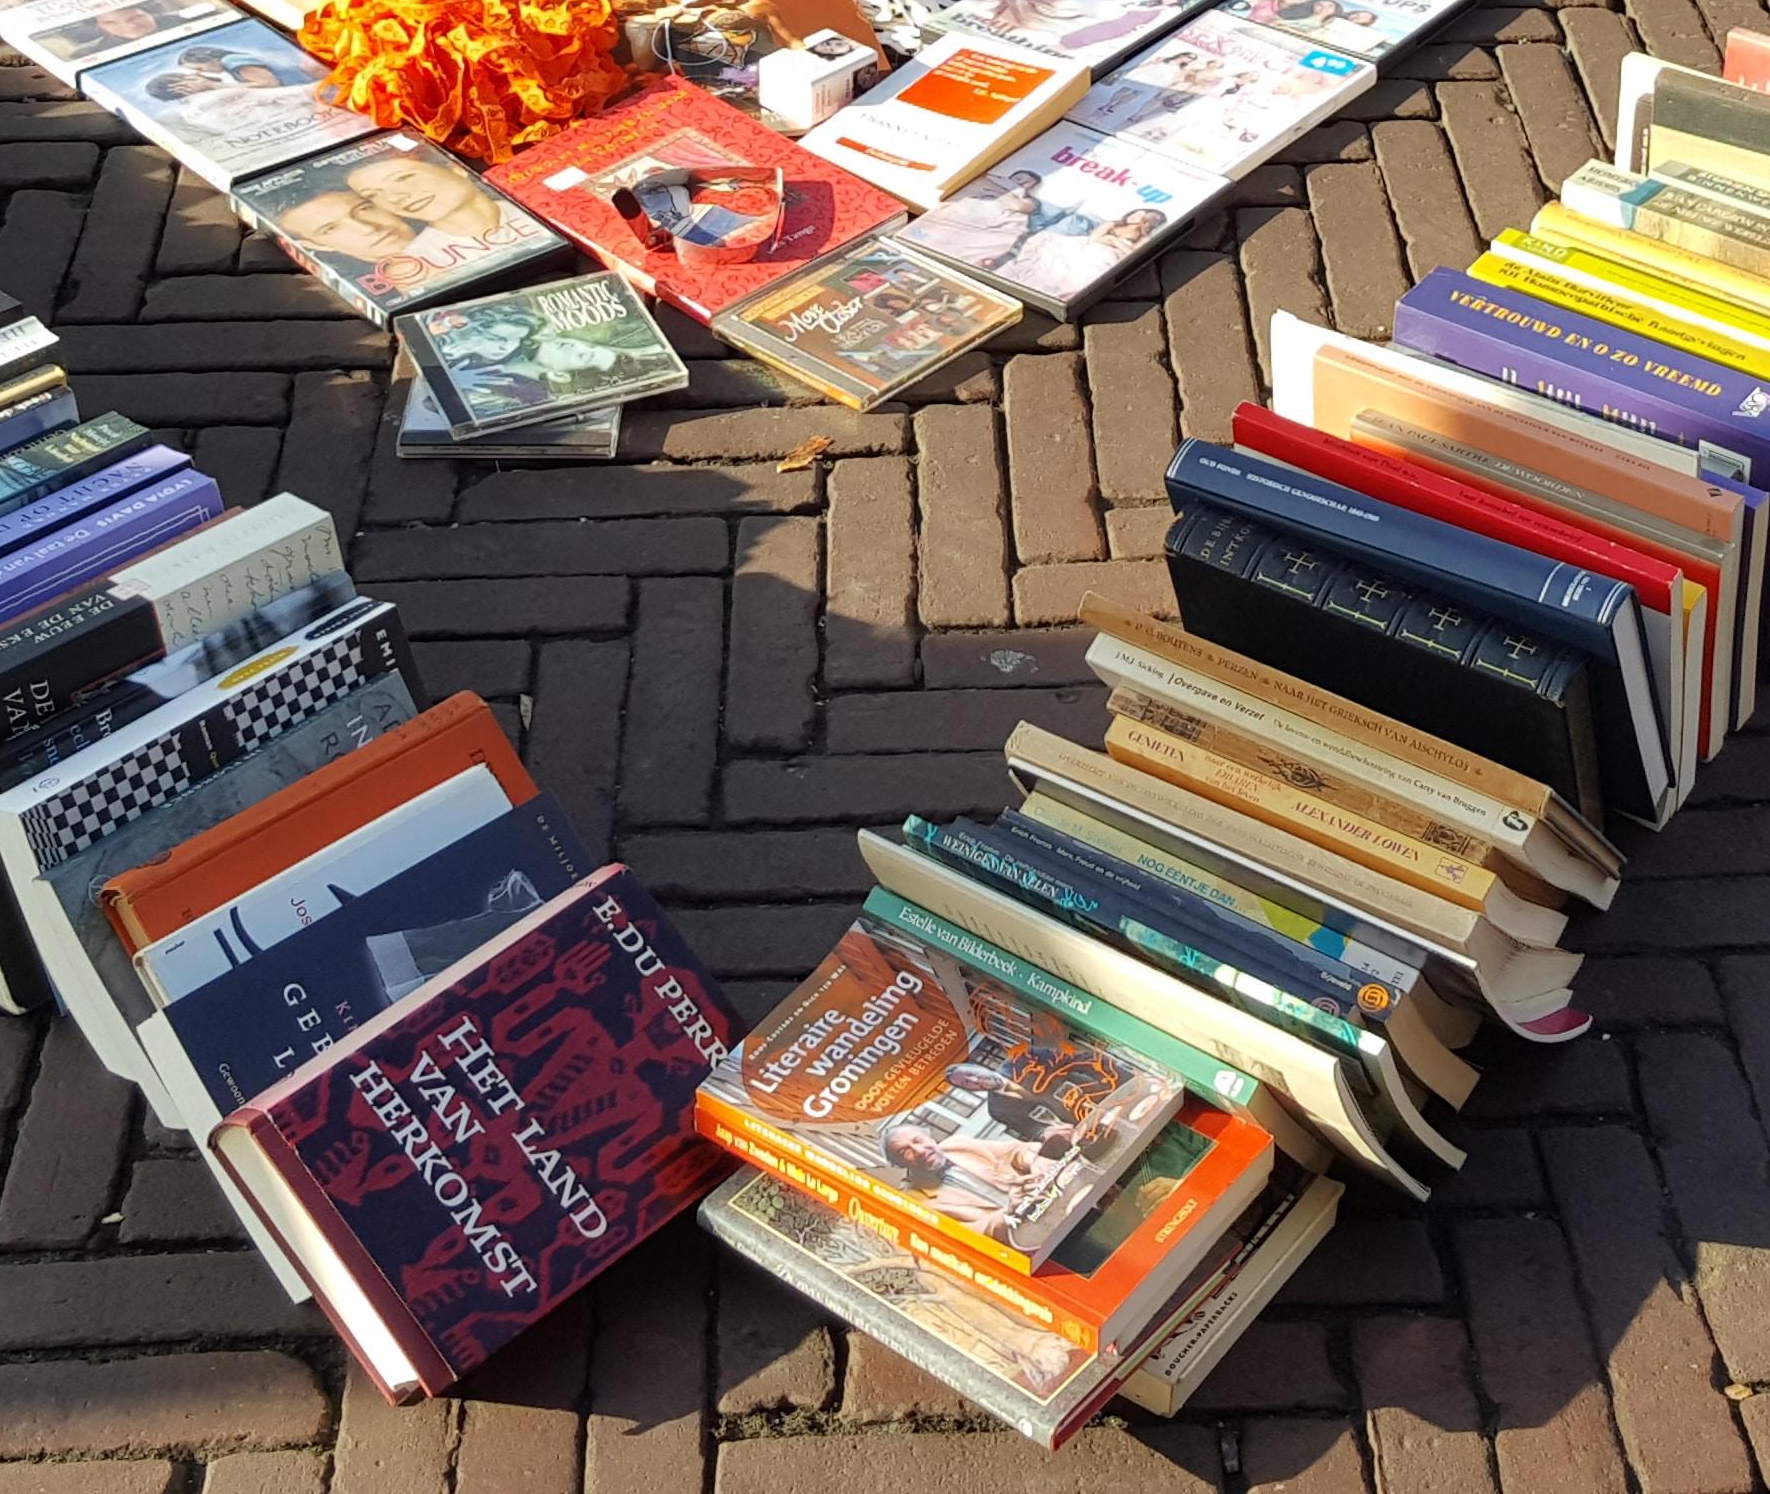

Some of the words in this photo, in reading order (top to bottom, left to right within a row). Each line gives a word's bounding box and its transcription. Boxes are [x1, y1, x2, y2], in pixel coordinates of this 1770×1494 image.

[1047, 141, 1178, 211] break-up
[351, 203, 541, 302] BOUNCE
[536, 278, 613, 314] ROMANTIC
[547, 296, 628, 332] MOODS
[1448, 288, 1564, 341] VERTROUWD
[1563, 331, 1594, 352] EN
[1591, 341, 1611, 358] O
[1608, 348, 1639, 368] ZO
[1642, 359, 1723, 399] VREEMD
[1440, 439, 1489, 464] SARTRE
[55, 458, 144, 507] NACHT
[141, 474, 194, 506] LYDIA
[15, 501, 50, 525] OP
[93, 498, 145, 529] DAVIS
[32, 537, 67, 561] taal
[62, 524, 91, 545] De
[3, 552, 35, 573] van
[35, 611, 64, 630] DE
[66, 591, 107, 615] VAN
[86, 598, 114, 616] DE
[29, 612, 86, 645] EEUW
[1155, 629, 1204, 658] BOUTENS
[1216, 656, 1258, 682] PERZEN
[26, 677, 58, 717] DE
[1172, 675, 1219, 704] Overgave
[1218, 696, 1233, 708] en
[1233, 701, 1265, 722] Verzet
[1272, 679, 1305, 701] NAAR
[1304, 693, 1329, 710] HET
[1327, 703, 1383, 734] GRIEKSCH
[1383, 726, 1408, 745] VAN
[1408, 737, 1471, 772] AISCHYLOS
[1126, 728, 1187, 764] GENIETEN
[1203, 753, 1225, 768] naar
[1224, 762, 1243, 775] een
[1241, 768, 1283, 792] werkelijk
[1204, 774, 1222, 787] van
[1220, 780, 1238, 793] het
[1236, 787, 1261, 803] leven
[1410, 777, 1437, 798] Carry
[1435, 789, 1452, 802] van
[1450, 795, 1488, 820] Bruggen
[535, 814, 550, 832] DE
[1010, 825, 1029, 839] Erich
[1290, 797, 1373, 842] ALEXANDER
[1371, 832, 1423, 863] LOWEN
[1094, 864, 1105, 874] en
[1104, 868, 1115, 878] de
[1136, 852, 1166, 874] NOG
[897, 904, 938, 935] Estelle
[934, 926, 960, 947] van
[955, 935, 1019, 977] Bilderbeek
[1023, 970, 1093, 1018] Kampkind
[798, 964, 926, 1084] wandeling
[744, 1000, 850, 1100] Literaire
[796, 1003, 928, 1128] Groningen
[851, 1077, 889, 1113] DOOR
[878, 1015, 954, 1083] GEVLEUGELDE
[215, 1061, 250, 1105] Gewoon
[868, 1073, 915, 1115] VOETEN
[906, 1028, 961, 1077] BETREDEN
[398, 1042, 486, 1153] VAN
[433, 1011, 526, 1127] HET
[507, 1112, 613, 1251] LAND
[346, 1044, 539, 1318] HERKOMST
[1163, 1288, 1238, 1378] BOUCHER-PAPERBACKS
